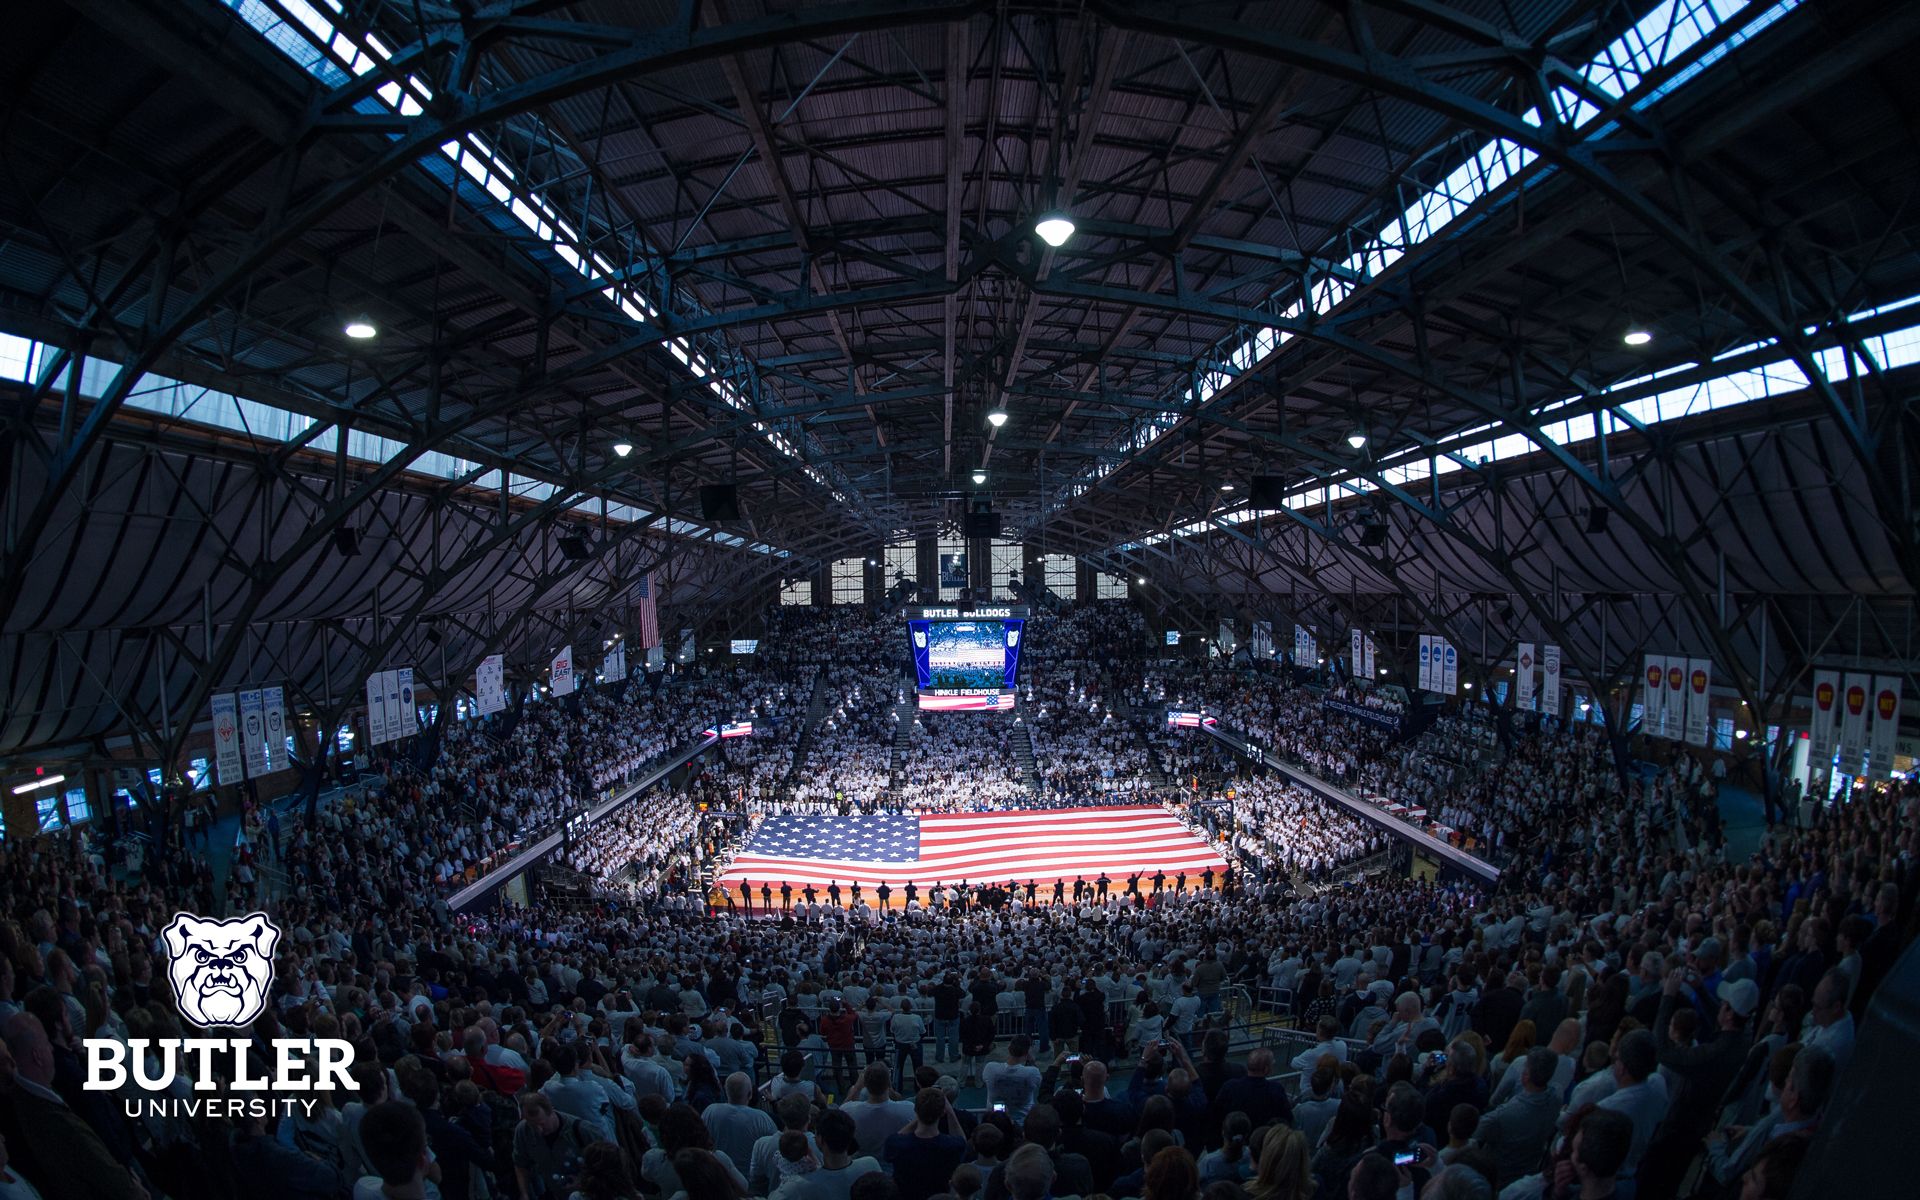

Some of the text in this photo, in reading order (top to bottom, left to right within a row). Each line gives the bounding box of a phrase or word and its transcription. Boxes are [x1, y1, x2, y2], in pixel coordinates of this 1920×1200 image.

[923, 608, 1011, 618] BUTLER BULLDOGS
[556, 660, 568, 669] BIG
[554, 668, 571, 678] EAST
[1693, 676, 1706, 687] NIT
[934, 688, 1000, 696] HINKLE FIELDHOUSE
[1818, 690, 1832, 703] NIT
[1848, 693, 1864, 706] NIT
[1879, 697, 1895, 711] NIT
